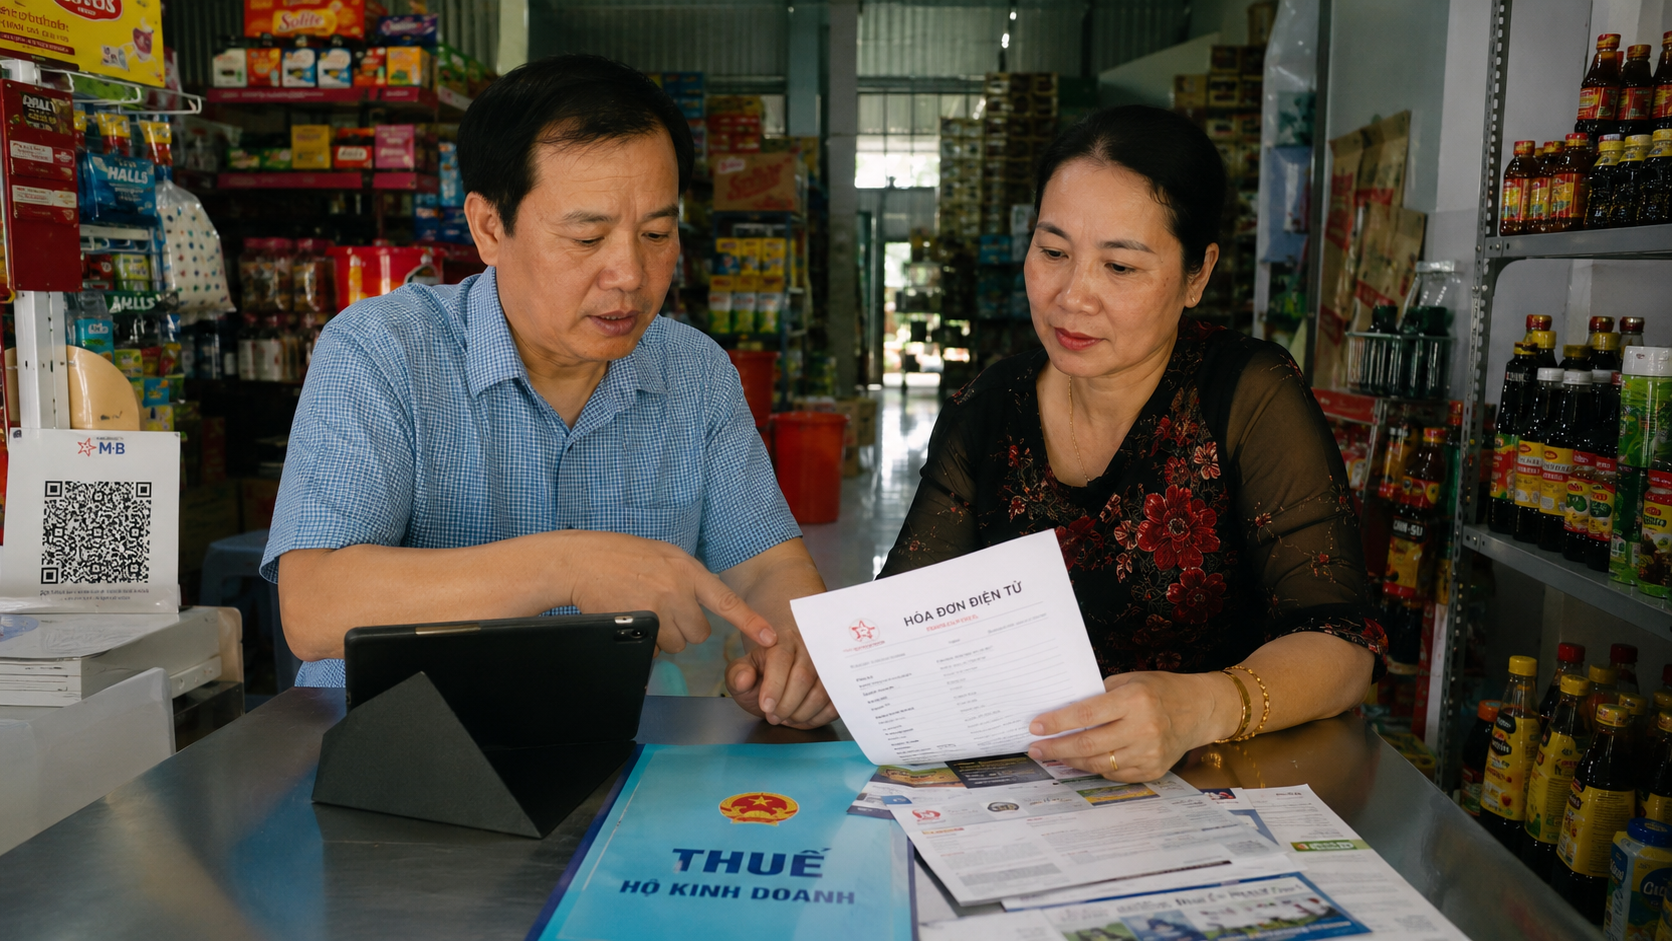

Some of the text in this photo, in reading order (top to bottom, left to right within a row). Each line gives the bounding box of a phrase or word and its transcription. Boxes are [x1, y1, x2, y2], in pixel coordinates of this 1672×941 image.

[279, 10, 325, 32] Solite
[107, 166, 149, 185] HALLS
[903, 610, 934, 627] HÓA
[936, 600, 966, 617] ĐƠN
[969, 590, 1001, 608] ĐIỆN
[1003, 580, 1022, 596] TỬ
[672, 847, 831, 878] THUẾ
[619, 878, 855, 905] HỘ KINH DOANH
